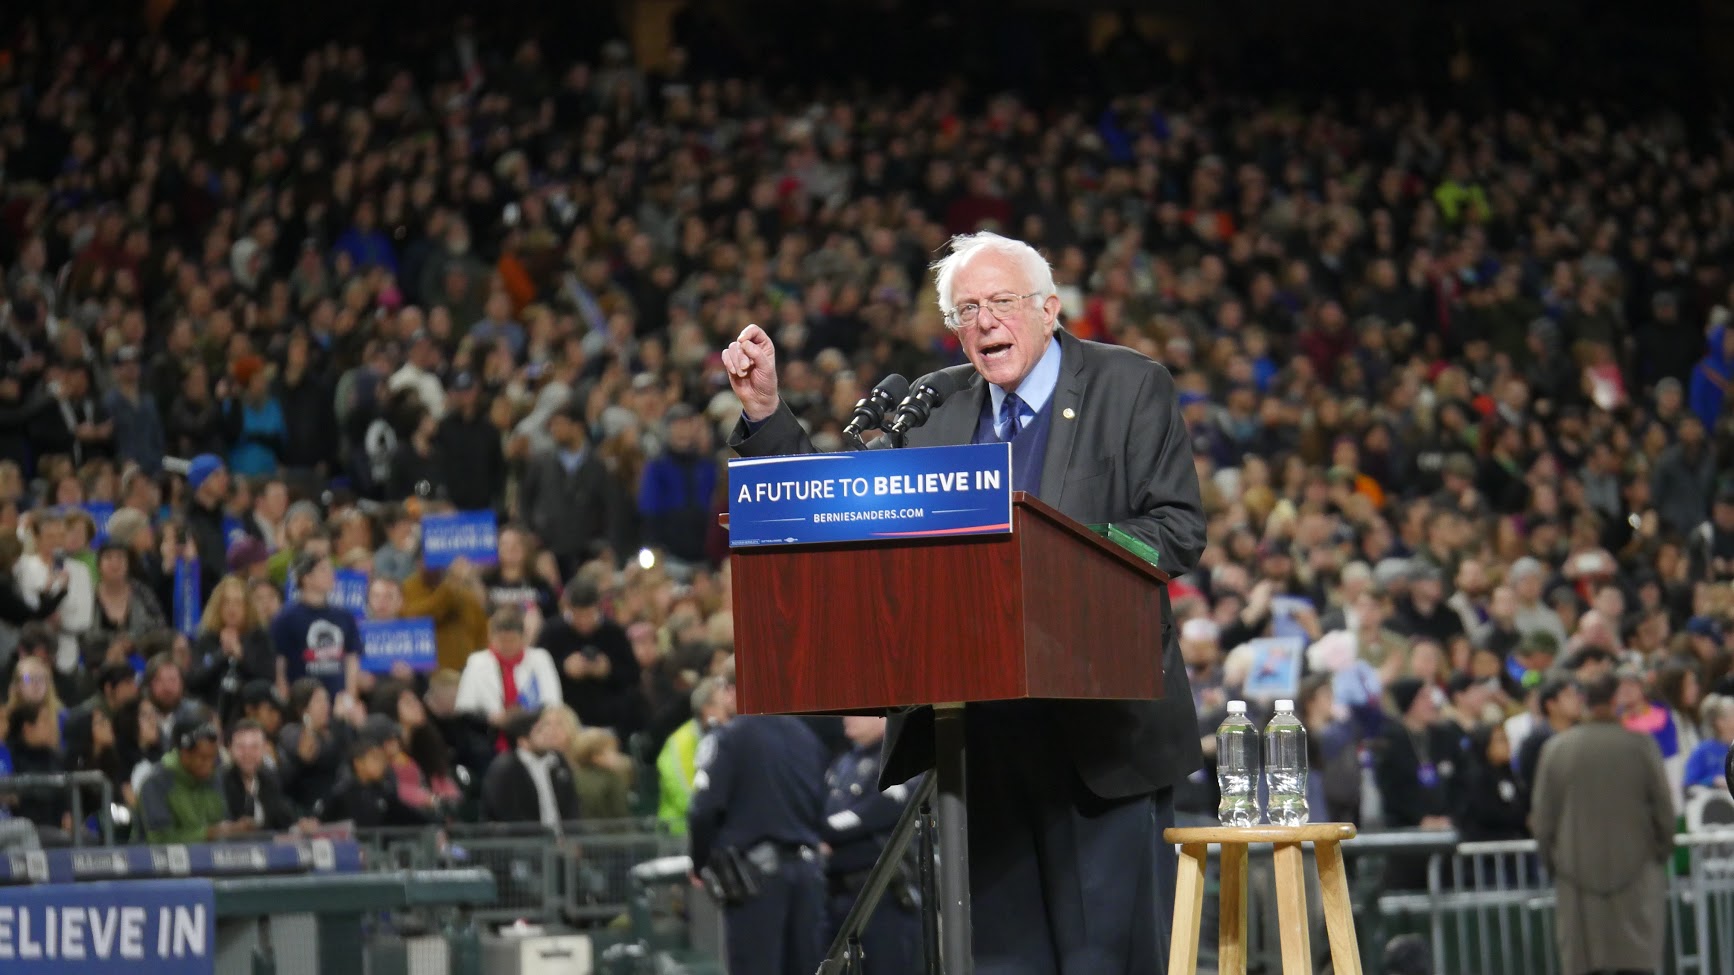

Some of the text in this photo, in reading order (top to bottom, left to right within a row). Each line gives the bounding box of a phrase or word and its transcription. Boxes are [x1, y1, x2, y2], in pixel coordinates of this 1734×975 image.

[738, 469, 1000, 503] A FUTURE TO BELIEVE IN
[813, 508, 924, 523] BERNIESANDERS.COM
[157, 903, 207, 959] IN
